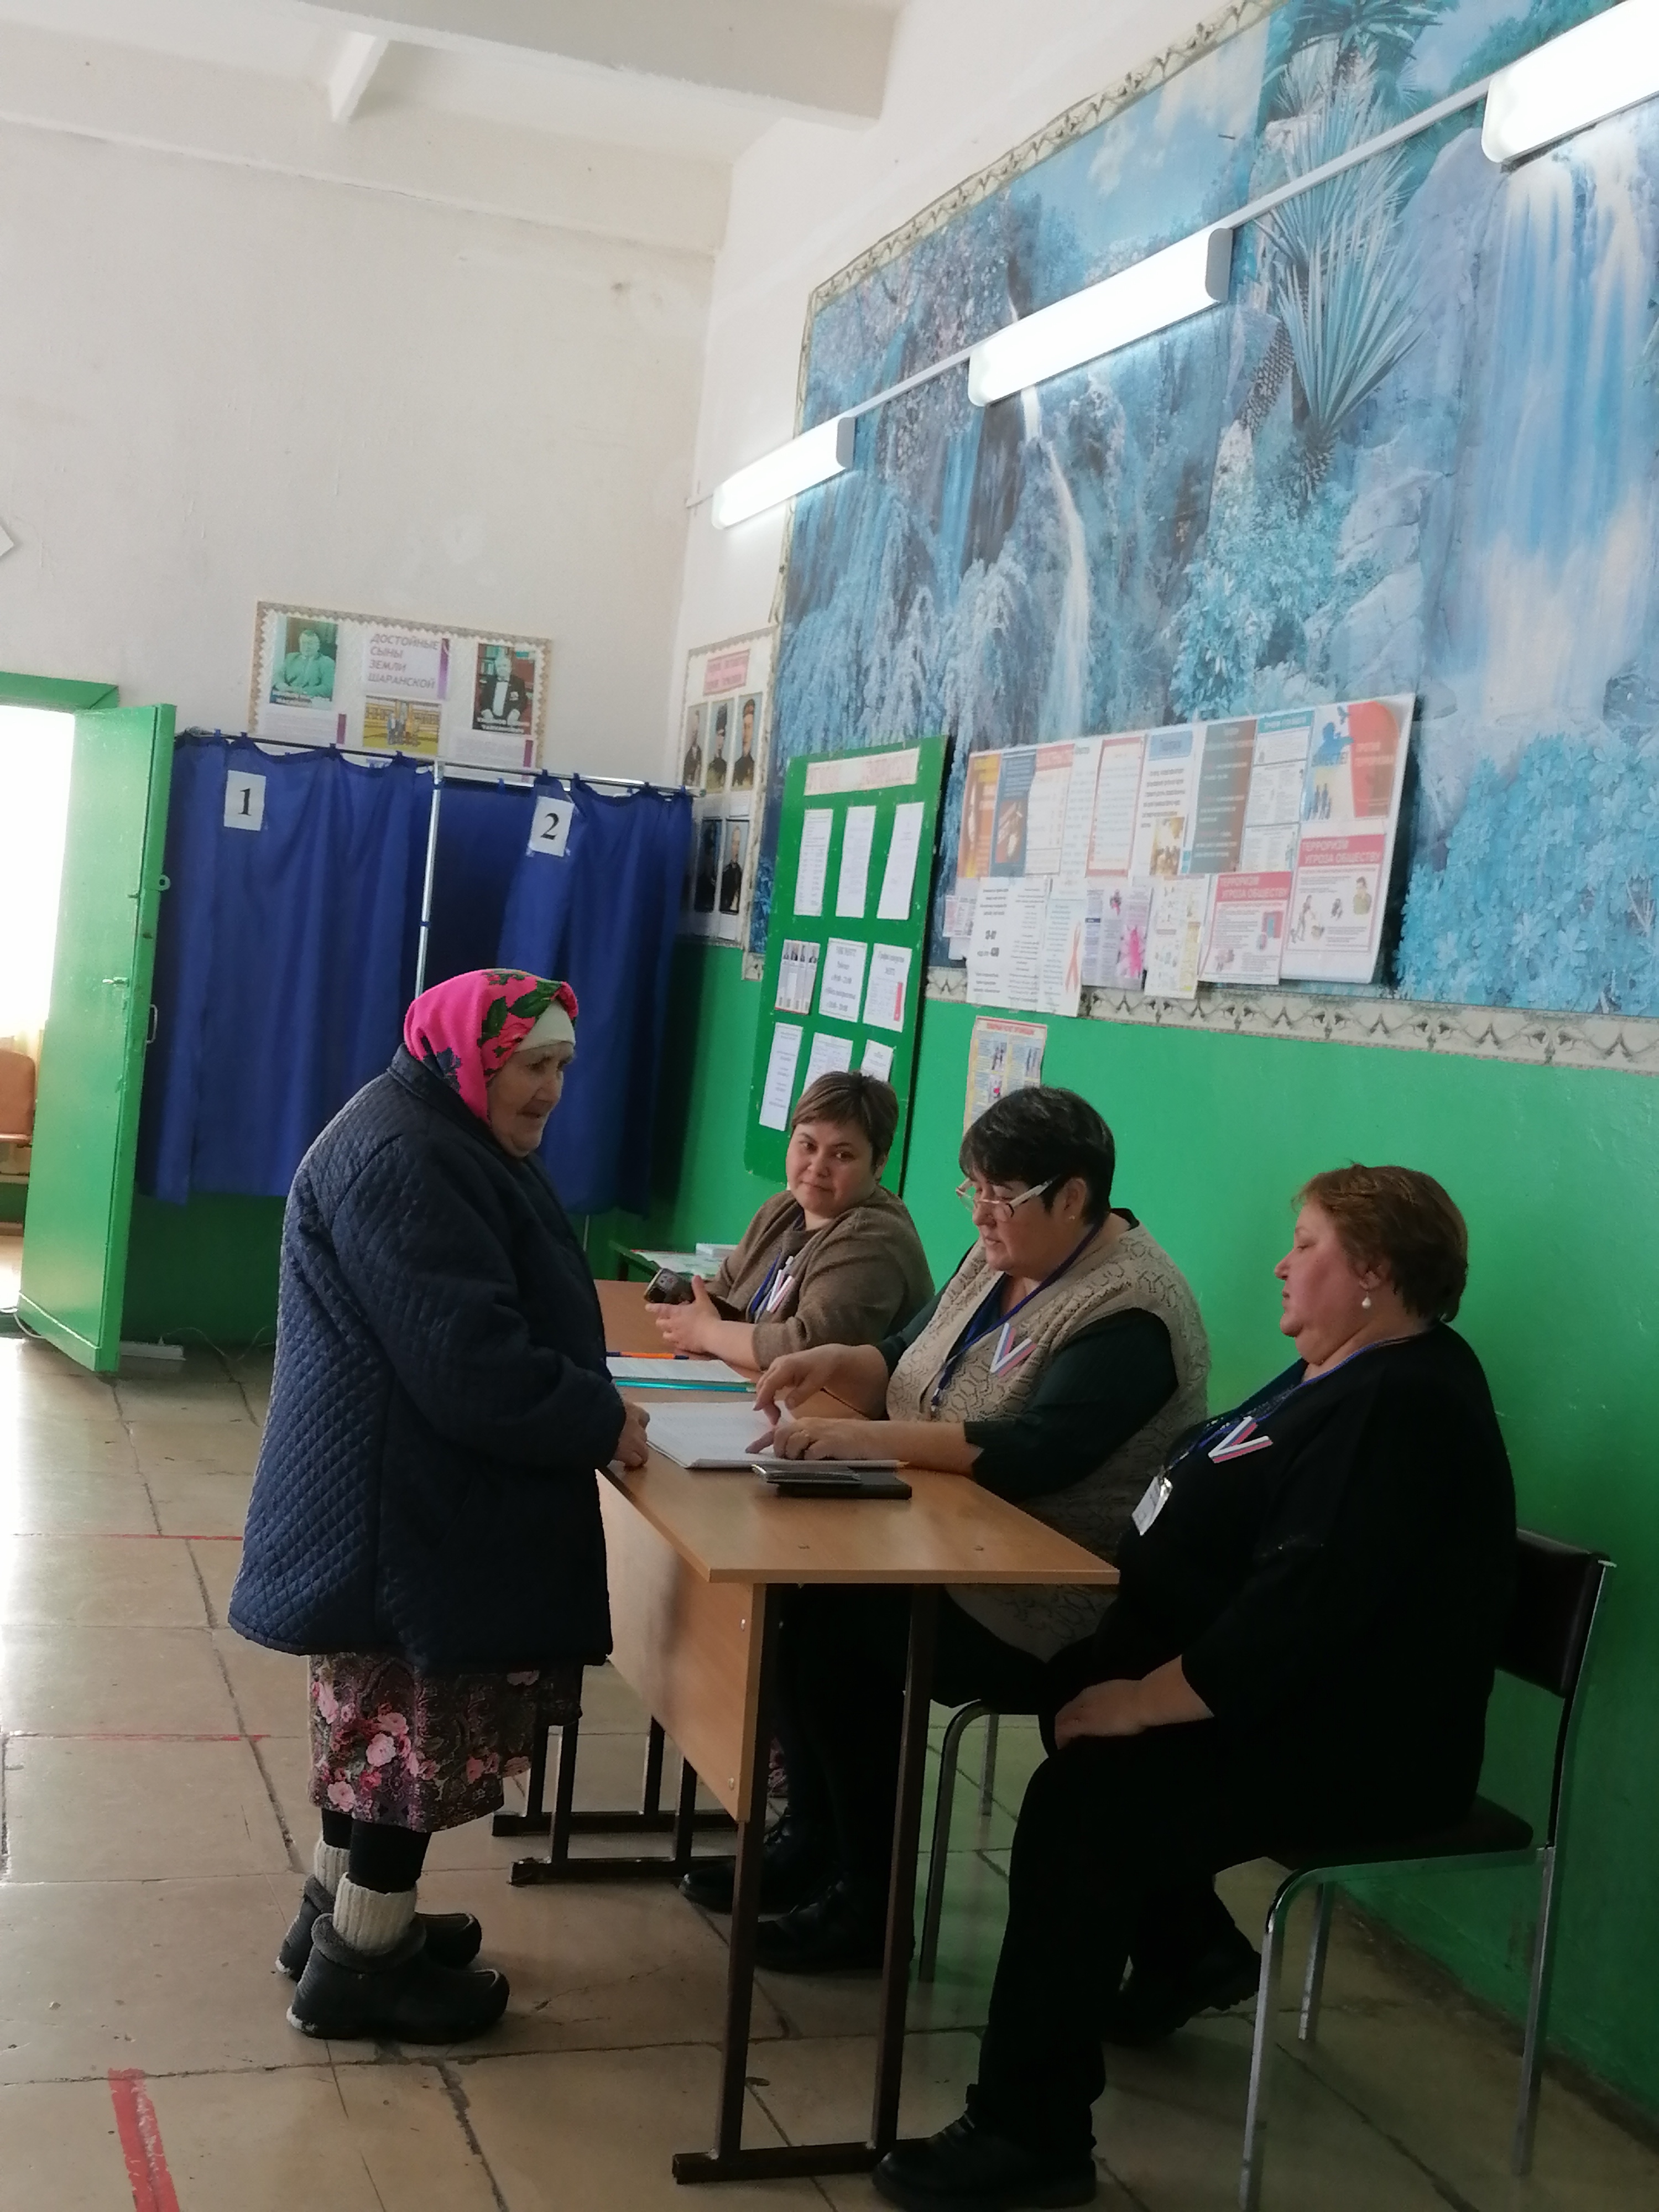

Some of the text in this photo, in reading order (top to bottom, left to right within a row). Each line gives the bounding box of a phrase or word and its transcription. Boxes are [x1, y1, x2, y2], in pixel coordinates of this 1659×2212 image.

[371, 633, 440, 650] ДОСТОЙНЫЕ
[370, 646, 404, 659] СЫНЫ
[368, 659, 407, 672] ЗЕМЛИ
[368, 673, 436, 689] ШАРАНСКОЙ
[239, 787, 252, 817] 1
[540, 812, 560, 841] 2
